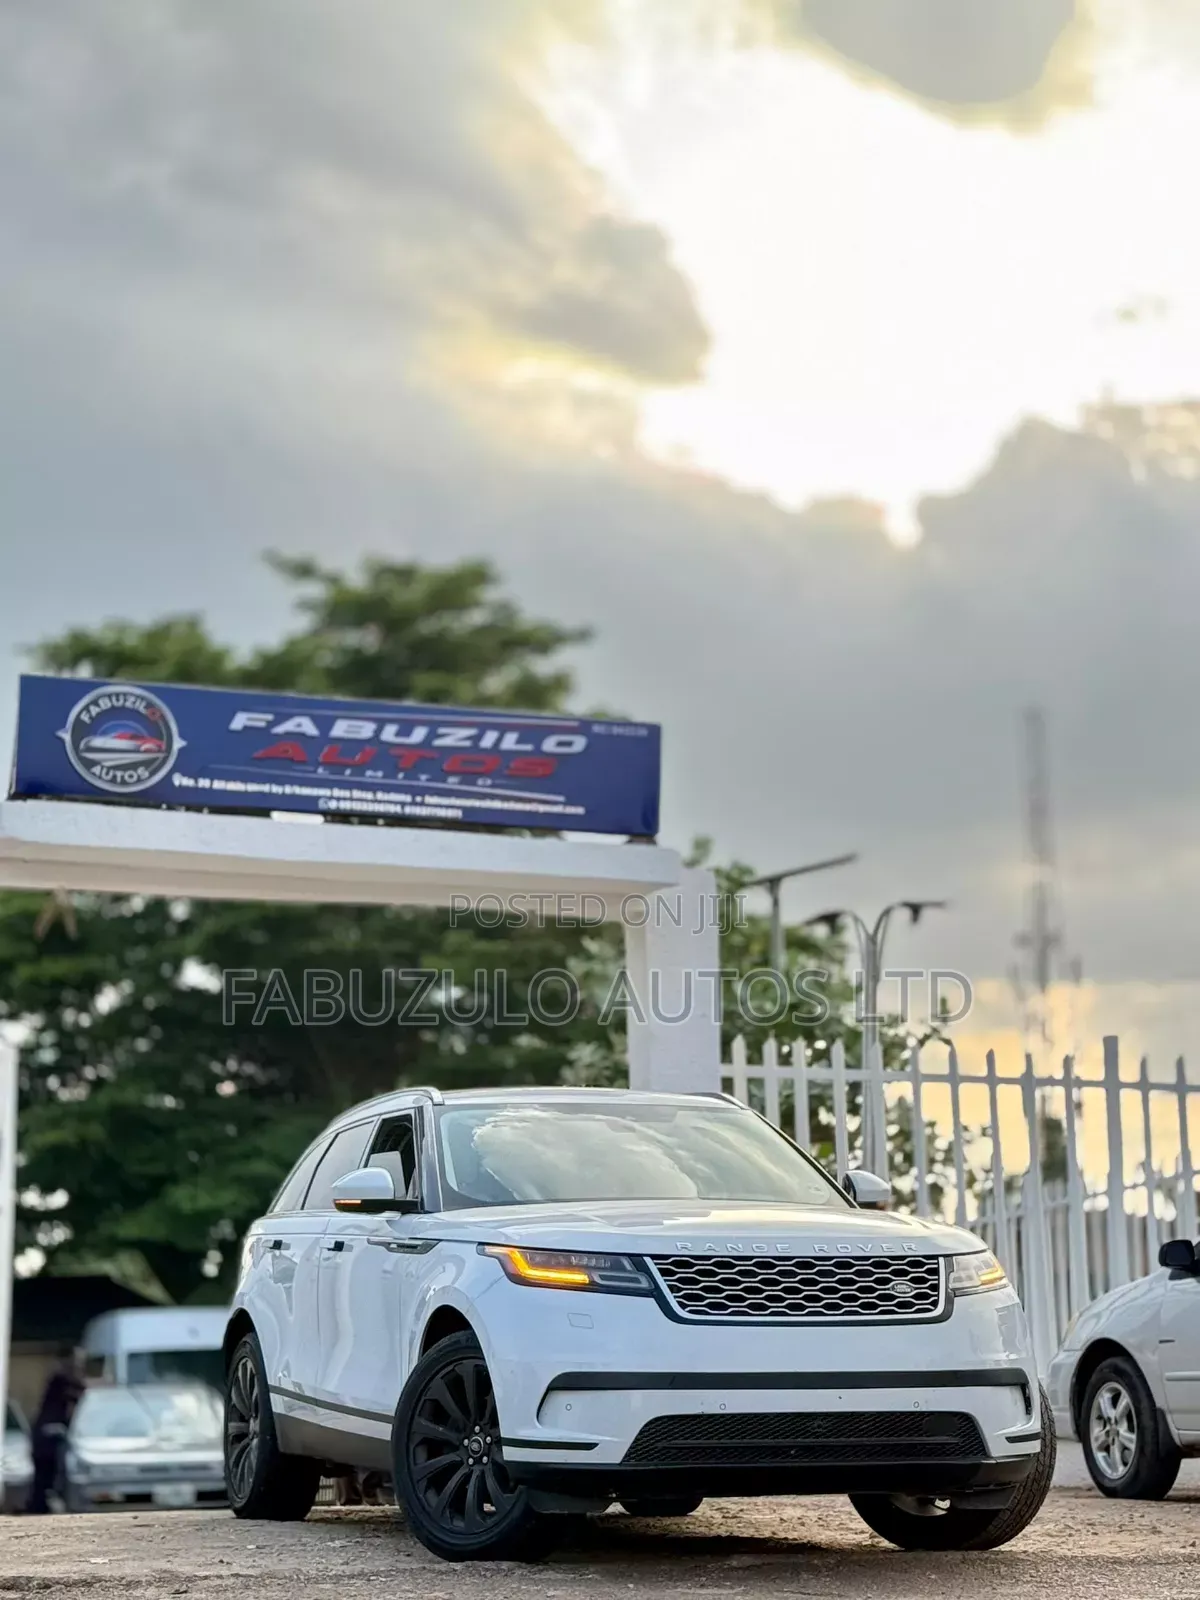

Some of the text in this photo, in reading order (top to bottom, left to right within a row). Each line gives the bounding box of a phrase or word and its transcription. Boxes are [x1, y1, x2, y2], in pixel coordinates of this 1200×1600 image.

[80, 693, 162, 724] FABUZILO
[228, 711, 589, 754] FABUZILO
[253, 741, 558, 778] AUTOS
[90, 765, 149, 783] AUTOS
[317, 765, 494, 787] LIMITED
[676, 1241, 919, 1254] RANGE ROVER
